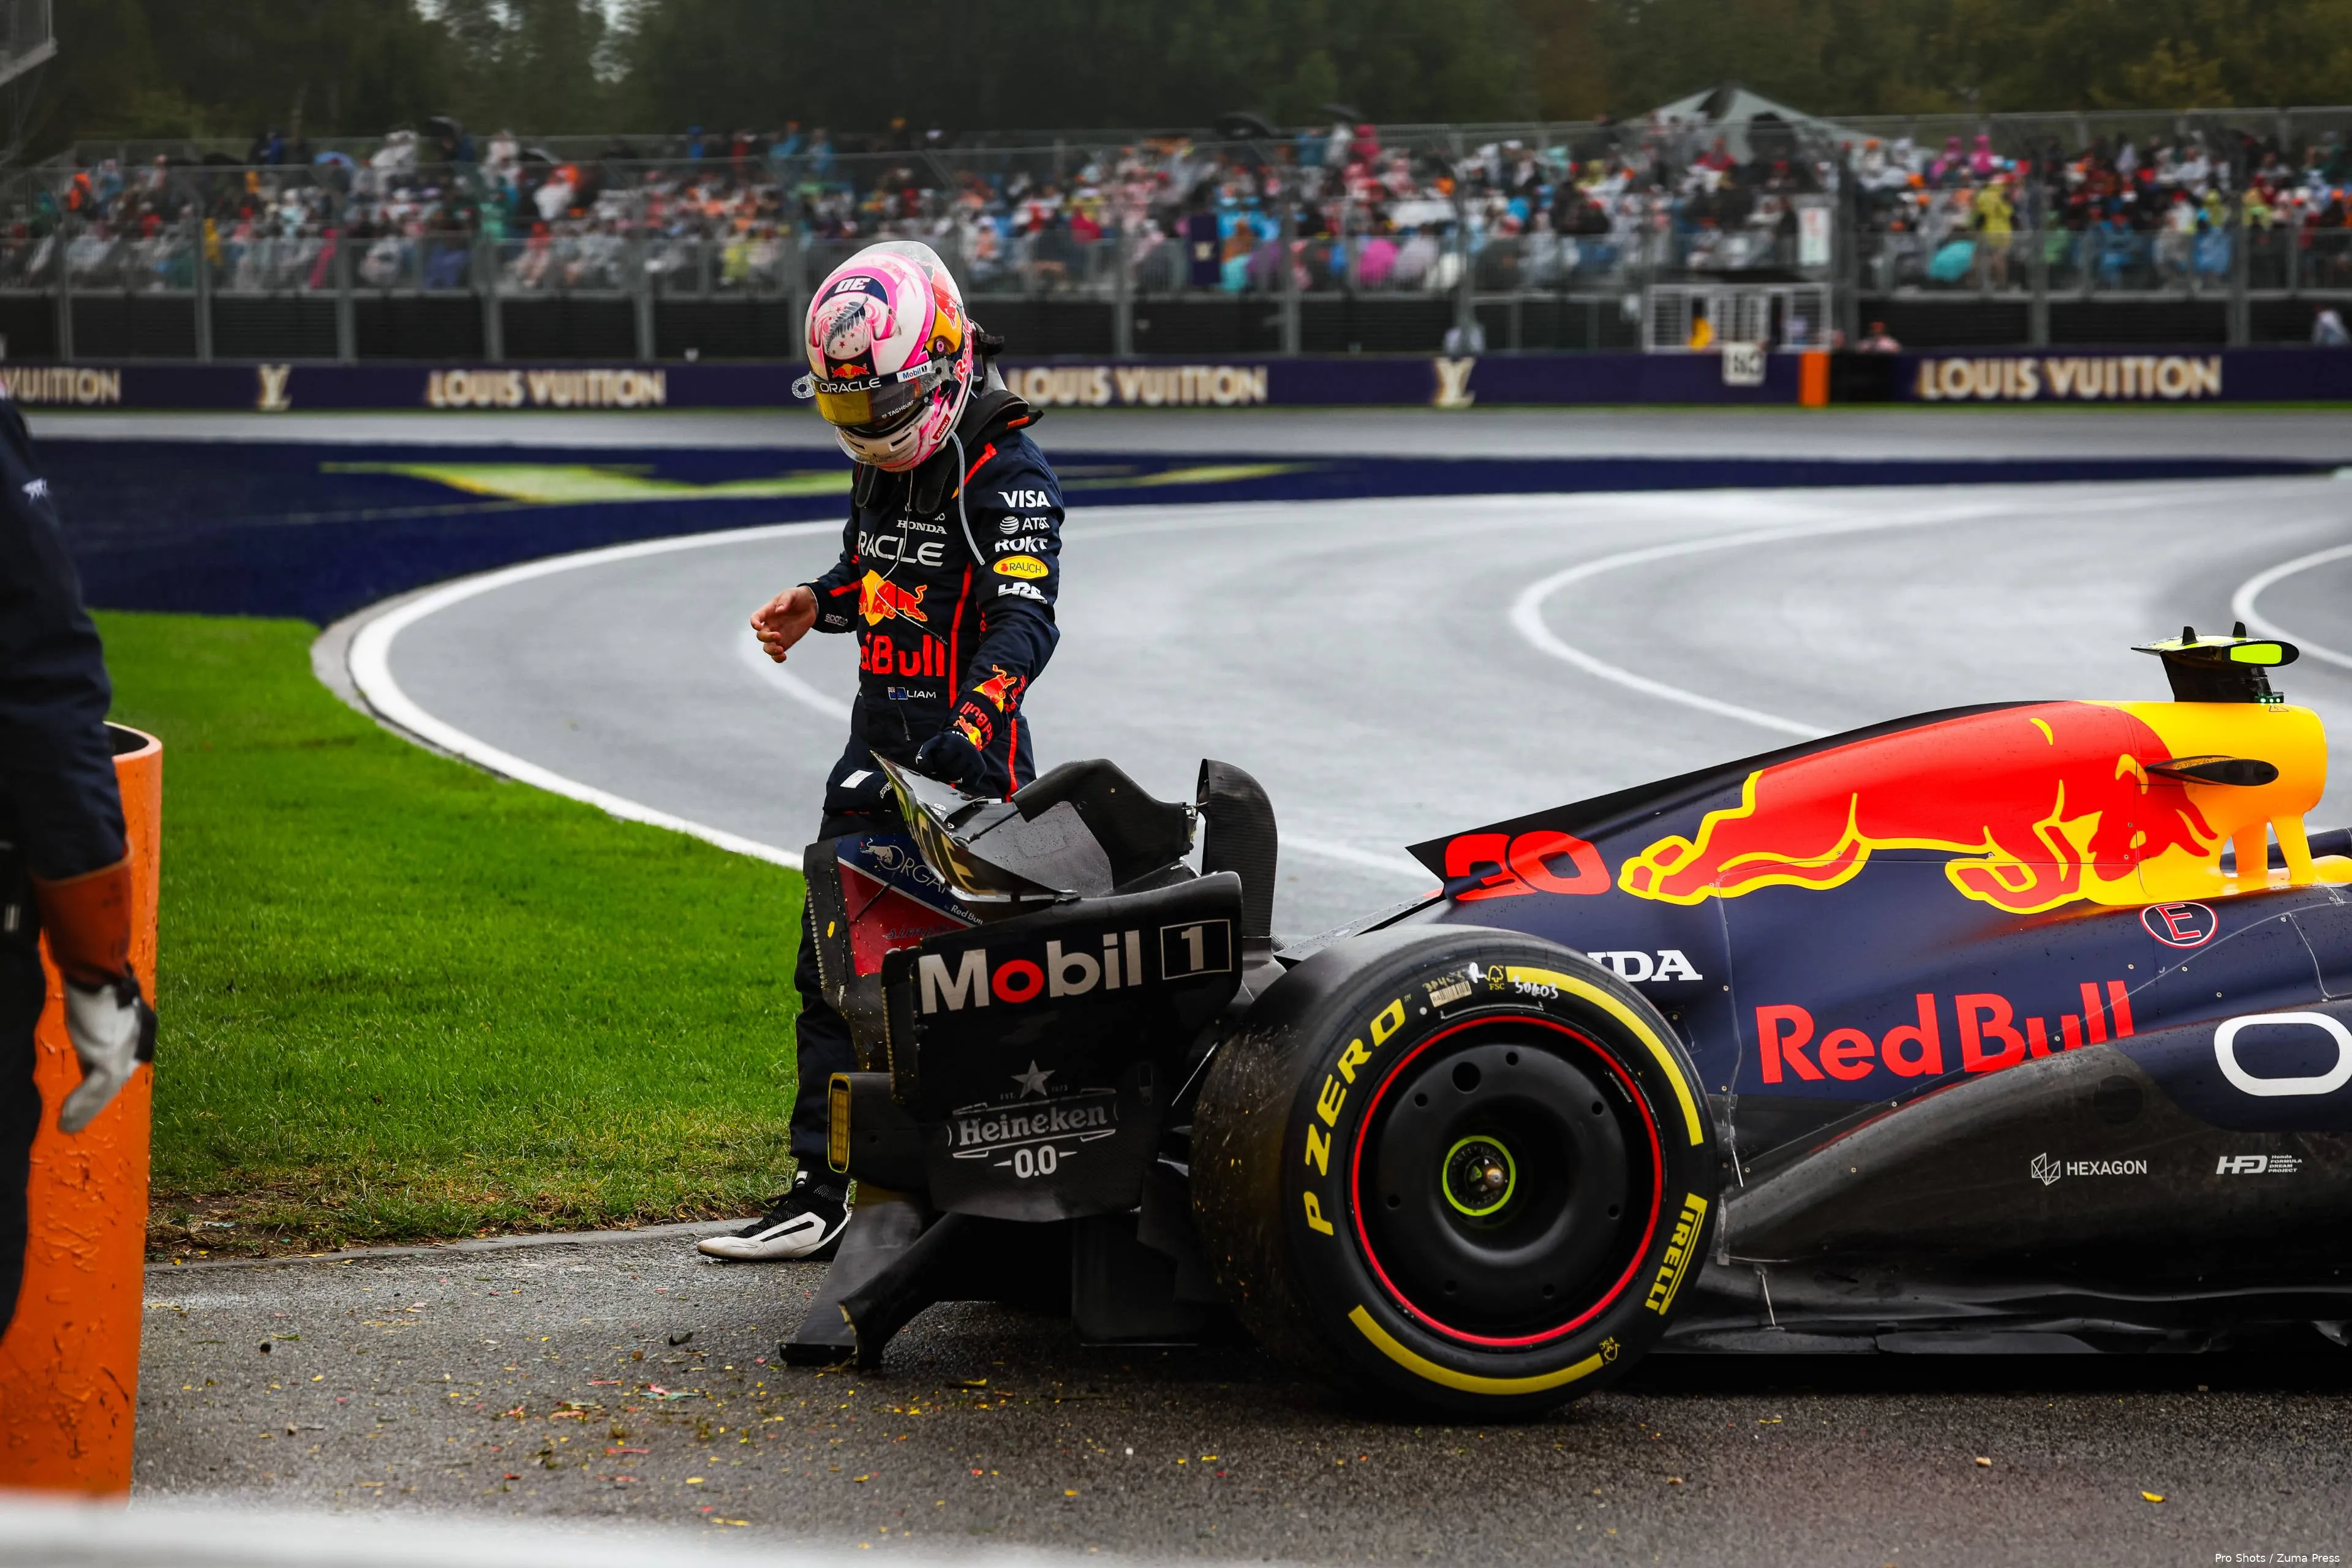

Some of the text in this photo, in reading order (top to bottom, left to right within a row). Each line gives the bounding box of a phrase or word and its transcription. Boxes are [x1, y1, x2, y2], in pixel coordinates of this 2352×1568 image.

[429, 369, 666, 407] LOUIS VUITTON
[820, 377, 881, 393] ORACLE
[902, 368, 921, 379] Mobil
[1006, 366, 1268, 406] LOUIS VUITTON
[1916, 356, 2222, 400] LOUIS VUITTON
[937, 418, 949, 438] ZURU
[998, 490, 1051, 508] VISA
[897, 519, 948, 534] HONDA
[995, 536, 1049, 552] ROKT
[858, 530, 945, 567] RACLE
[1010, 563, 1041, 574] RAUCH
[872, 635, 945, 676] Bull
[907, 690, 937, 699] LIAM
[951, 905, 968, 918] Red
[2155, 903, 2202, 941] E
[918, 926, 1204, 1014] Mobil 1
[1756, 980, 2135, 1084] Red Bull
[1305, 998, 1406, 1176] ZERO
[958, 1106, 1108, 1146] Heineken
[1014, 1145, 1057, 1178] 0.0
[2067, 1160, 2147, 1176] HEXAGON
[1303, 1191, 1333, 1236] P
[1645, 1193, 1708, 1315] PIRELLI
